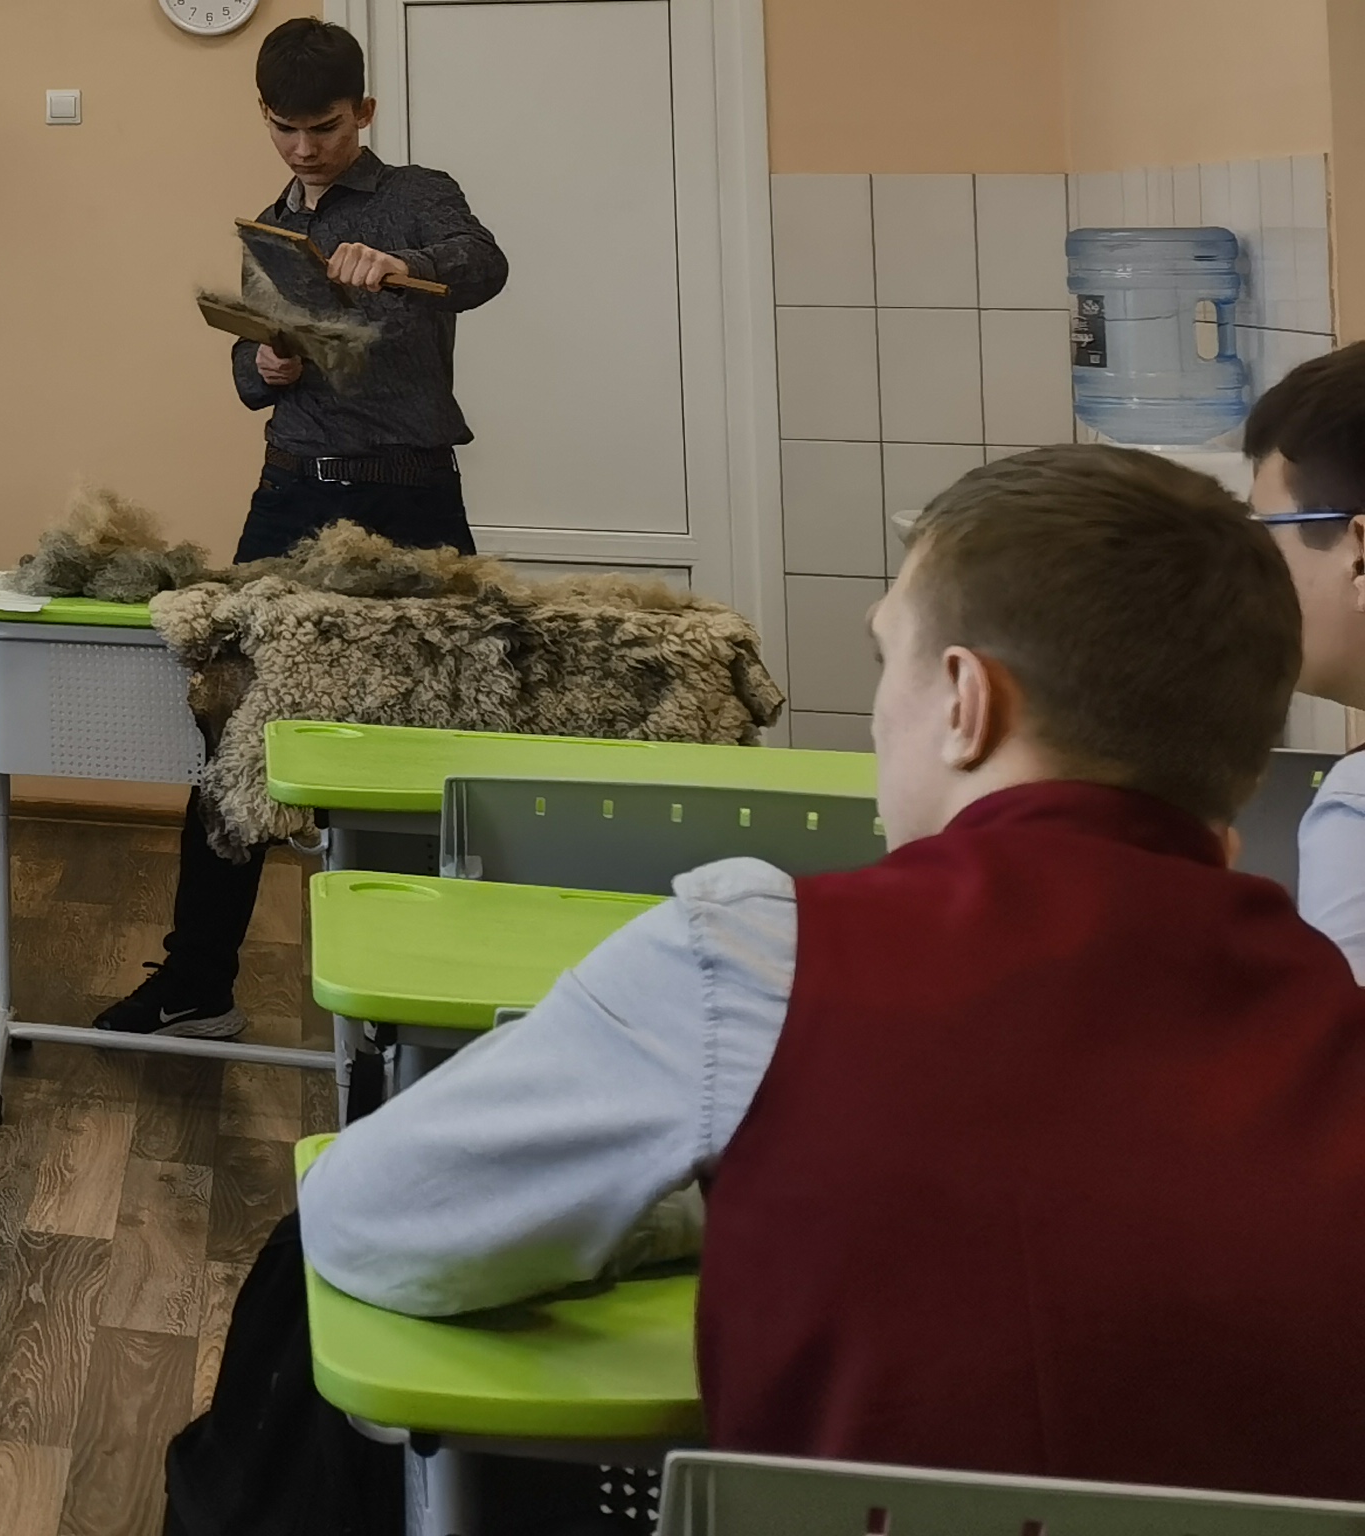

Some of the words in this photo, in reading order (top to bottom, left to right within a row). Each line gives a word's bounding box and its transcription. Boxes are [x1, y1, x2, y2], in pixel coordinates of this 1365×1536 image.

[190, 7, 197, 17] 7
[222, 7, 230, 16] 5
[206, 12, 213, 22] 6
